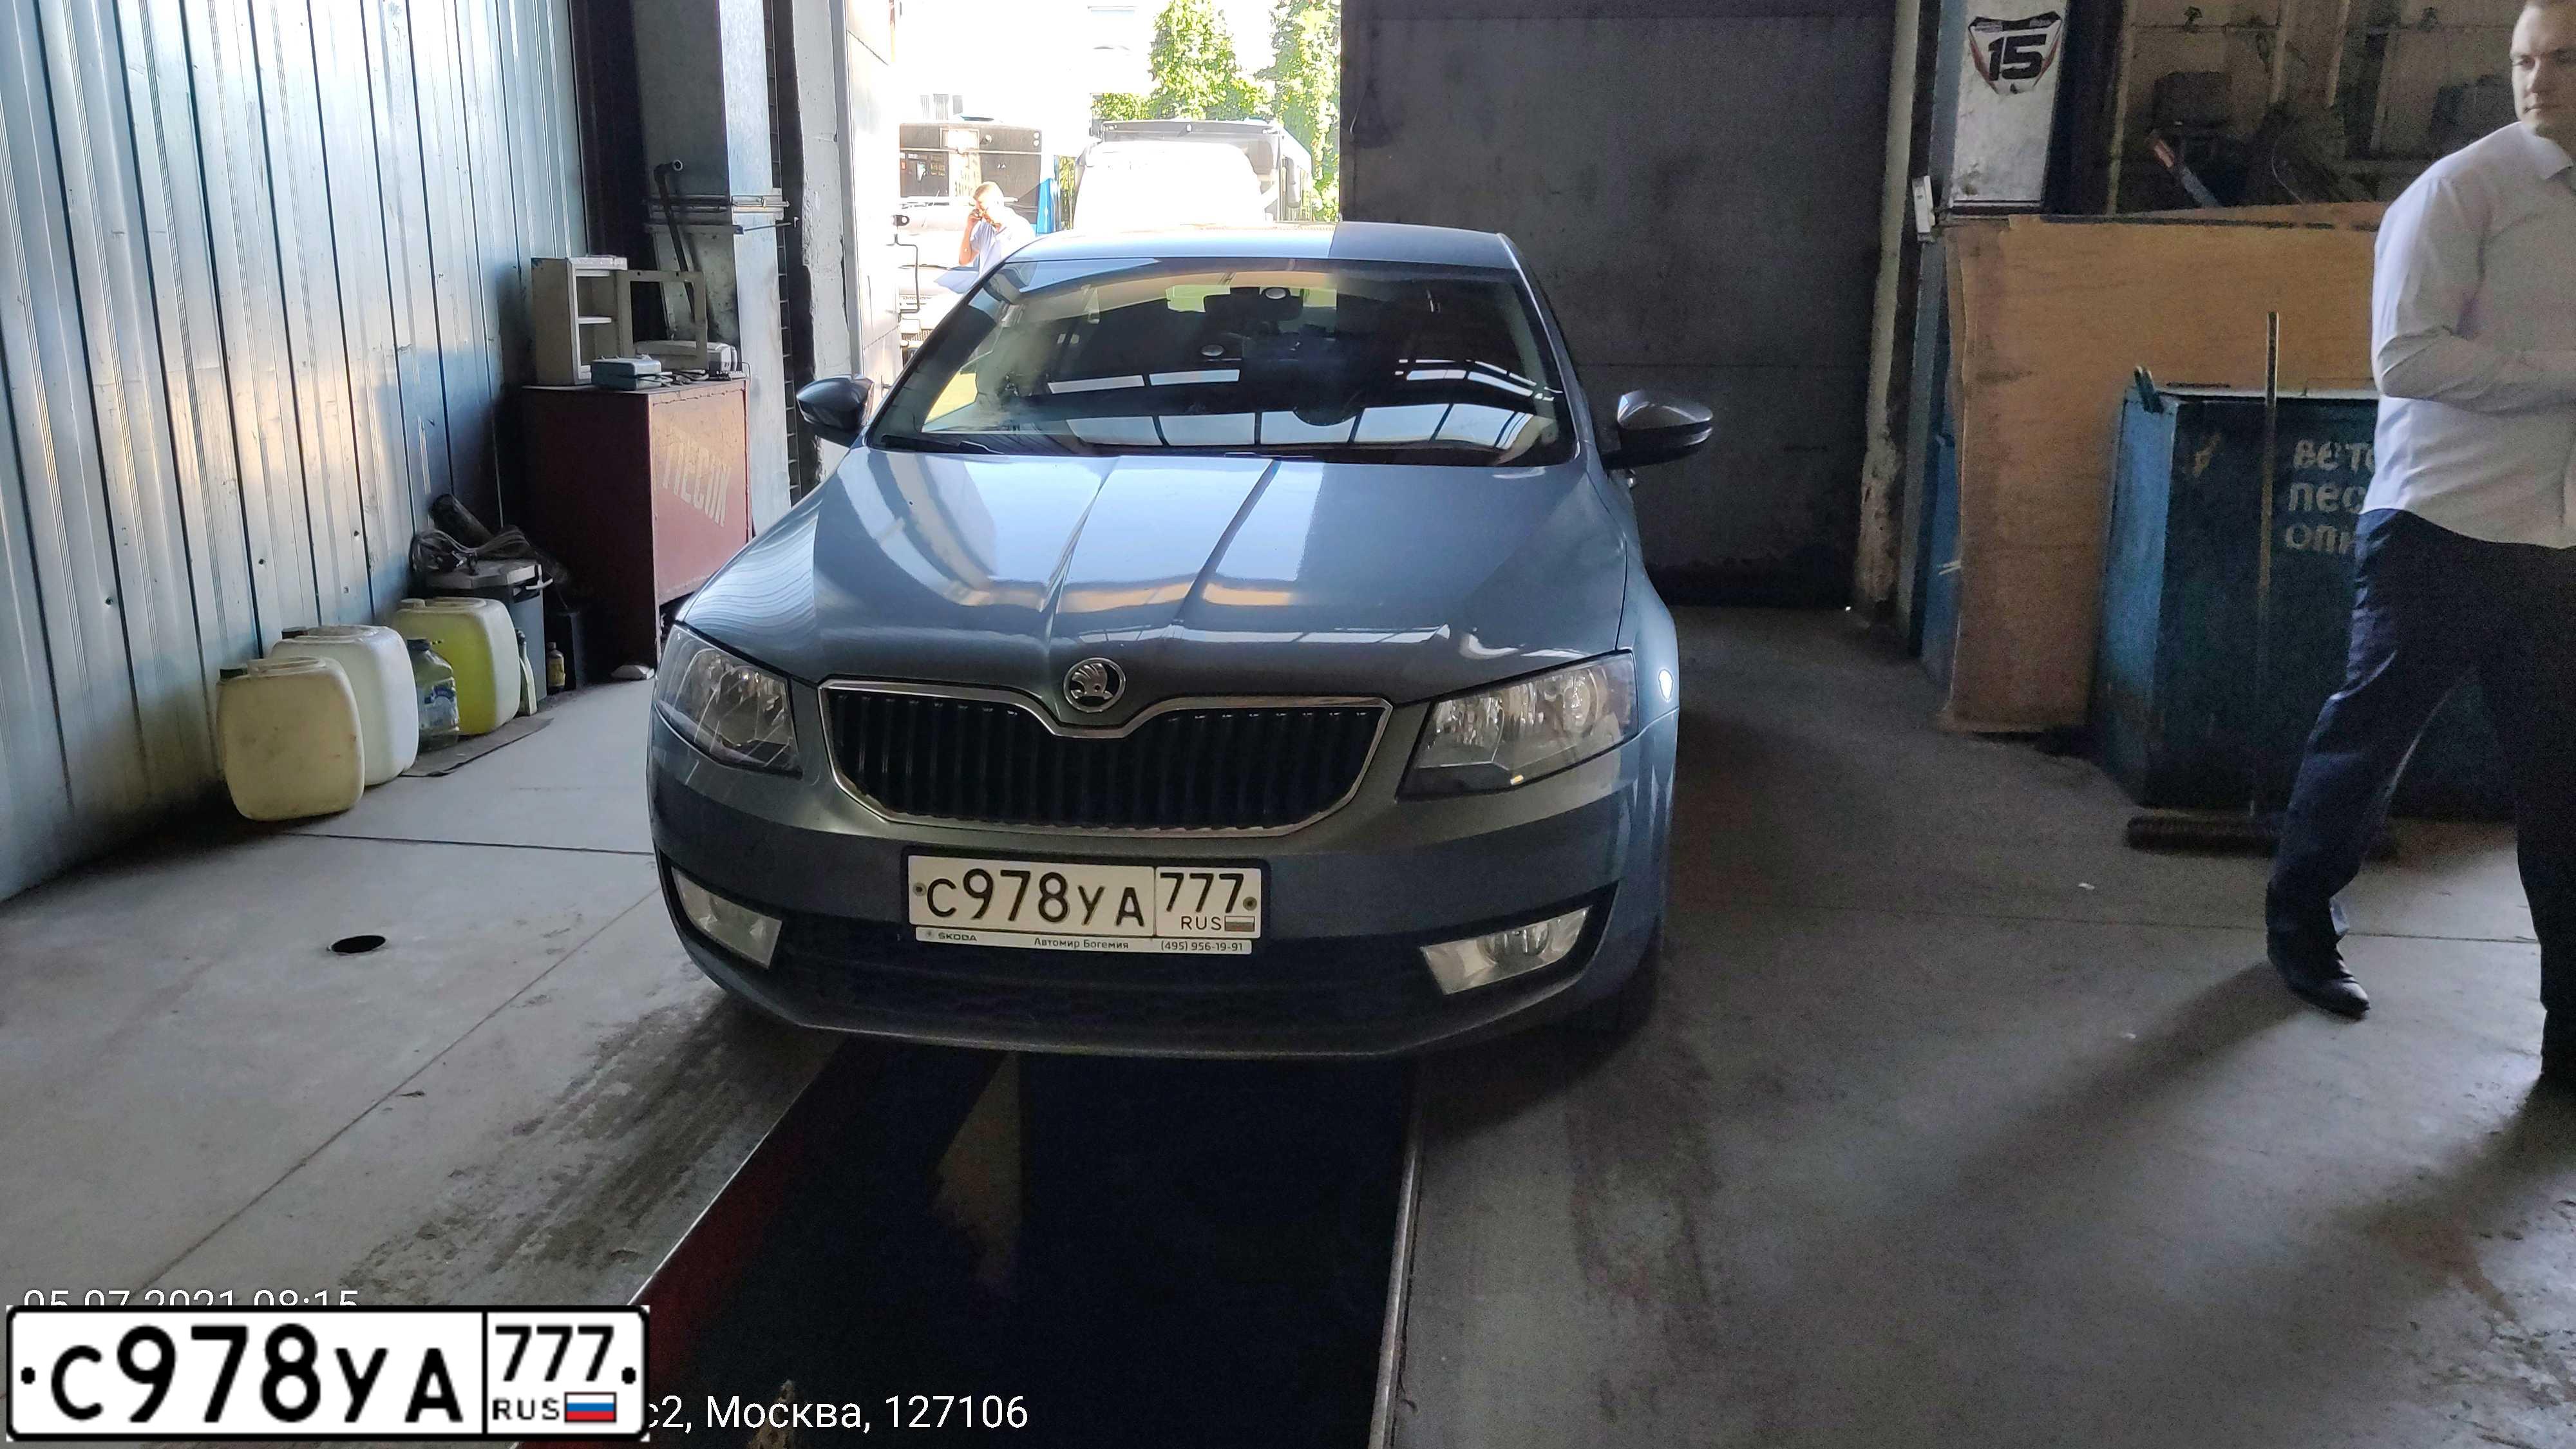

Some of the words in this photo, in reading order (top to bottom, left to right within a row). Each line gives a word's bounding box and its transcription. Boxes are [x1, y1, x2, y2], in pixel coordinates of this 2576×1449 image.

[1988, 33, 2047, 81] 15
[1160, 872, 1244, 913] 777
[1181, 916, 1222, 931] RUS
[1034, 936, 1081, 949] Автомир
[1083, 939, 1129, 949] Богемия
[1160, 940, 1188, 951] (495)
[1191, 942, 1243, 952] 956-19-91
